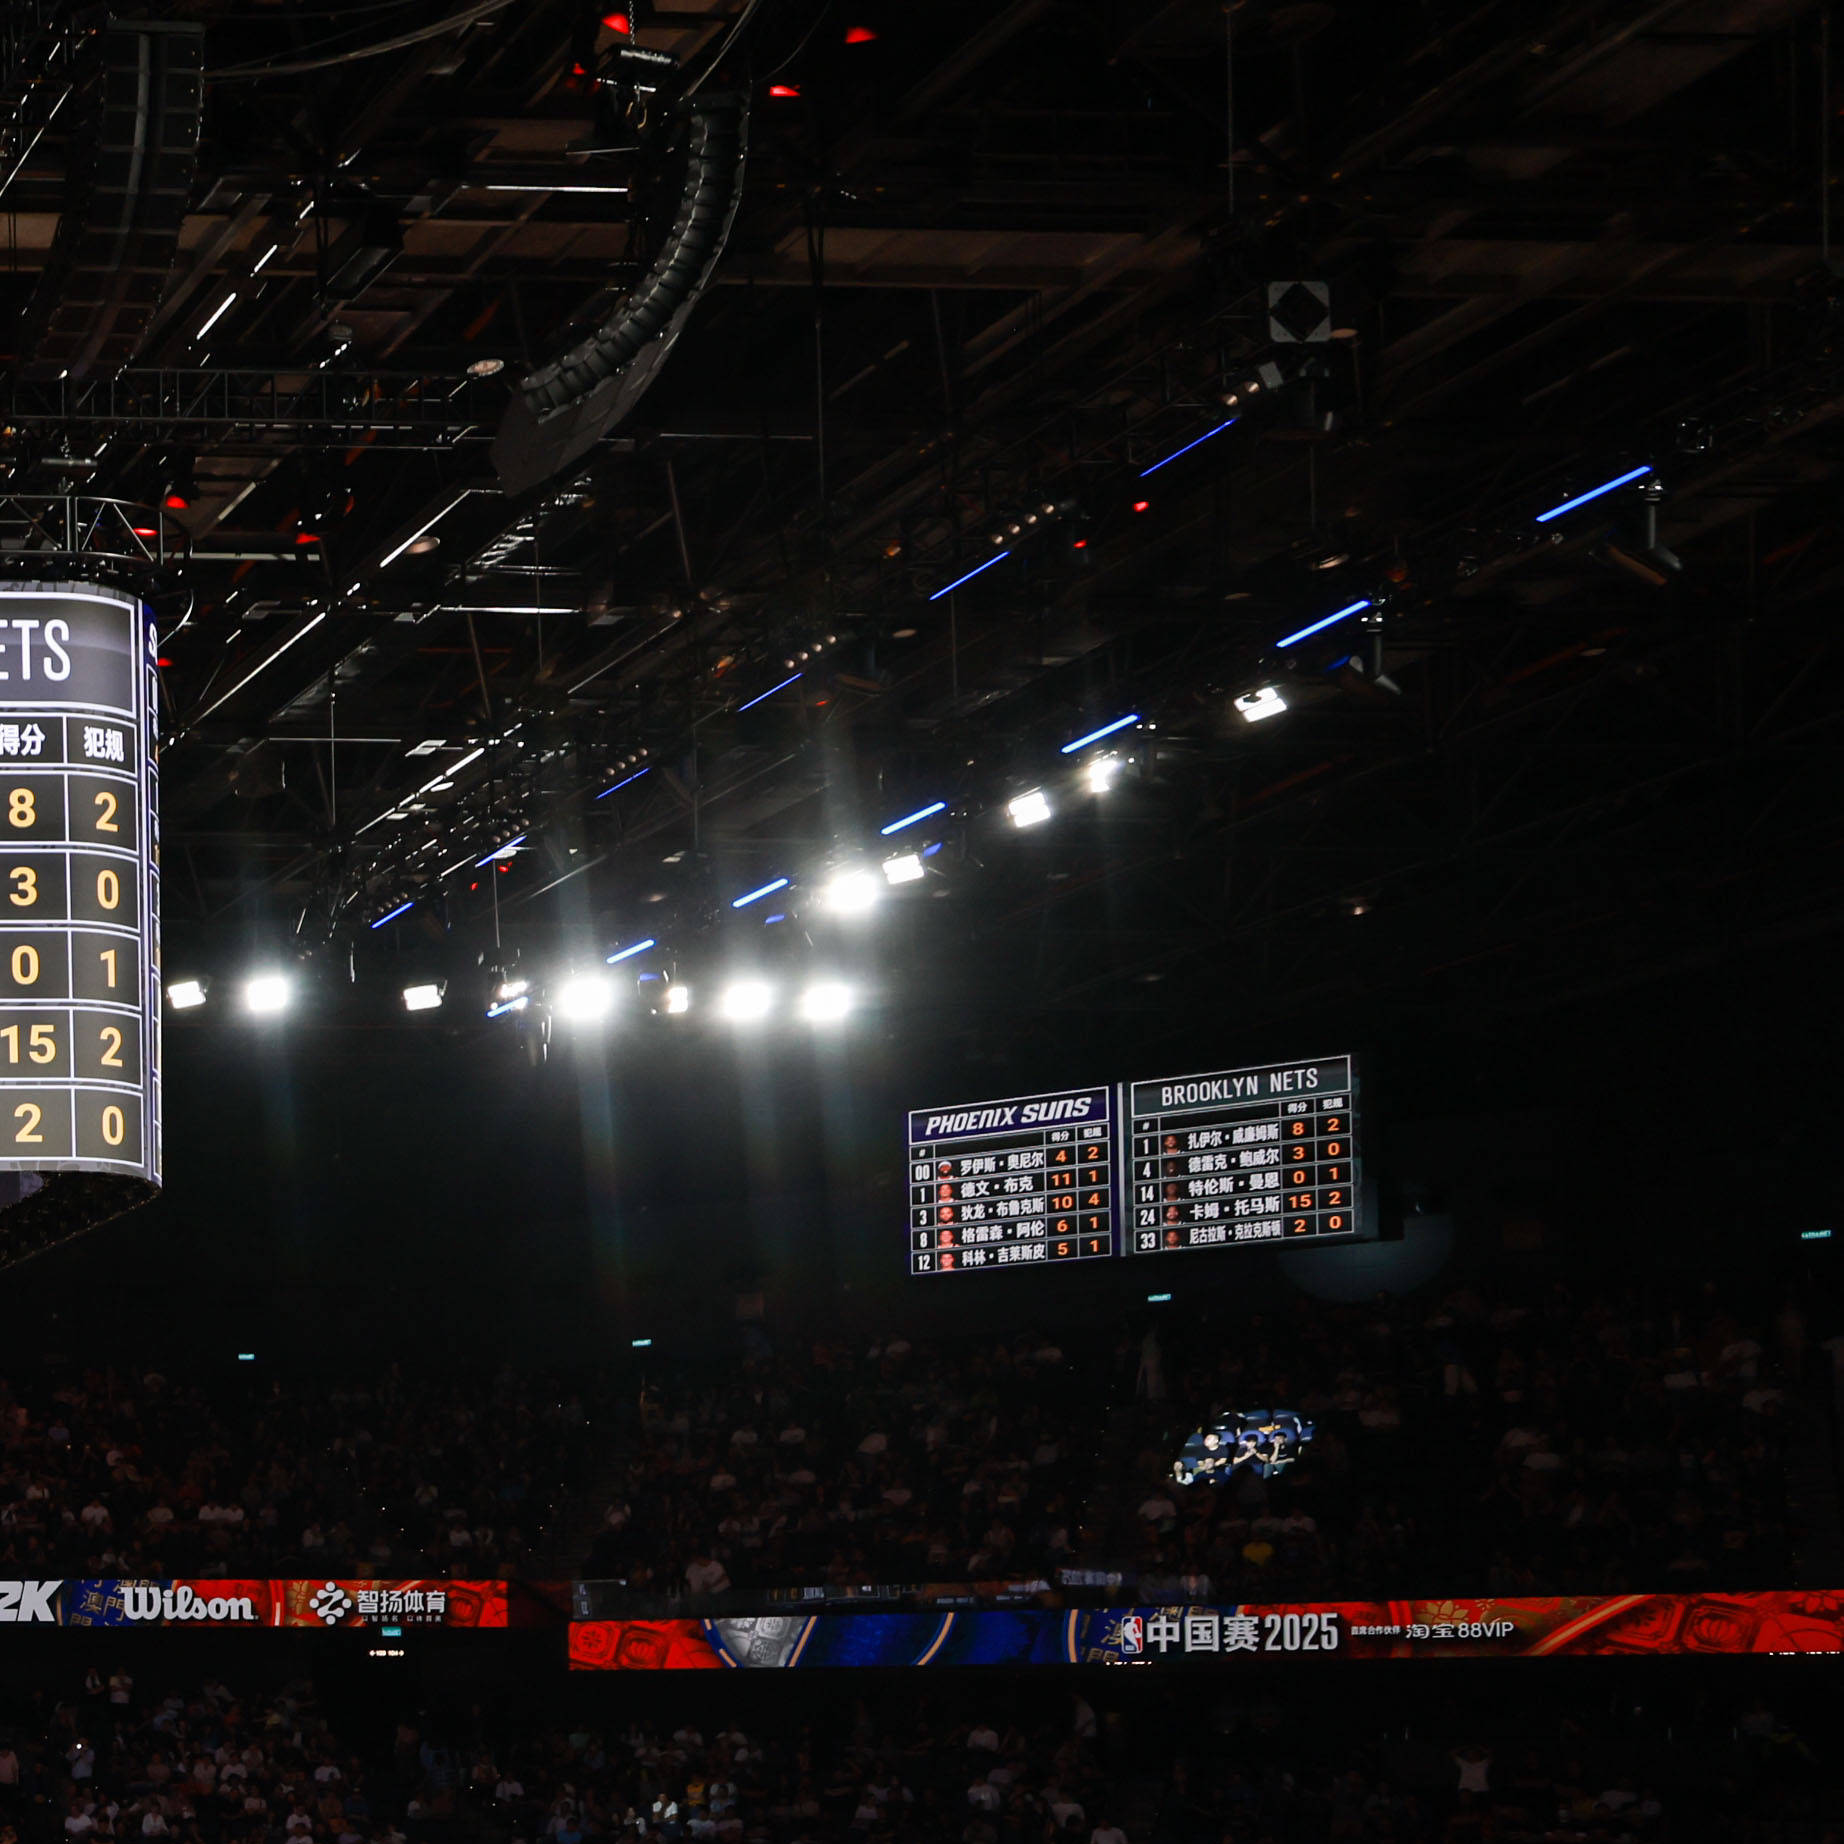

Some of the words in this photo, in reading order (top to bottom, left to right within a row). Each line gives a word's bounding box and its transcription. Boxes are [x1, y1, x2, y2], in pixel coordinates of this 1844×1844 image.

[84, 726, 124, 761] 犯规
[9, 788, 35, 827] 8
[95, 792, 118, 832] 2
[10, 867, 37, 906] 3
[98, 870, 118, 909] 0
[12, 946, 38, 984] 0
[101, 950, 115, 987] 1
[0, 1025, 55, 1063] 15
[100, 1027, 122, 1066] 2
[1161, 1077, 1258, 1106] BROOKLYN
[1270, 1068, 1319, 1093] NETS
[15, 1103, 42, 1142] 2
[103, 1106, 123, 1145] 0
[925, 1108, 1016, 1136] PHOENIX
[1022, 1097, 1091, 1123] SUNS
[118, 1585, 256, 1621] Wilson
[357, 1590, 445, 1613] 智扬体育
